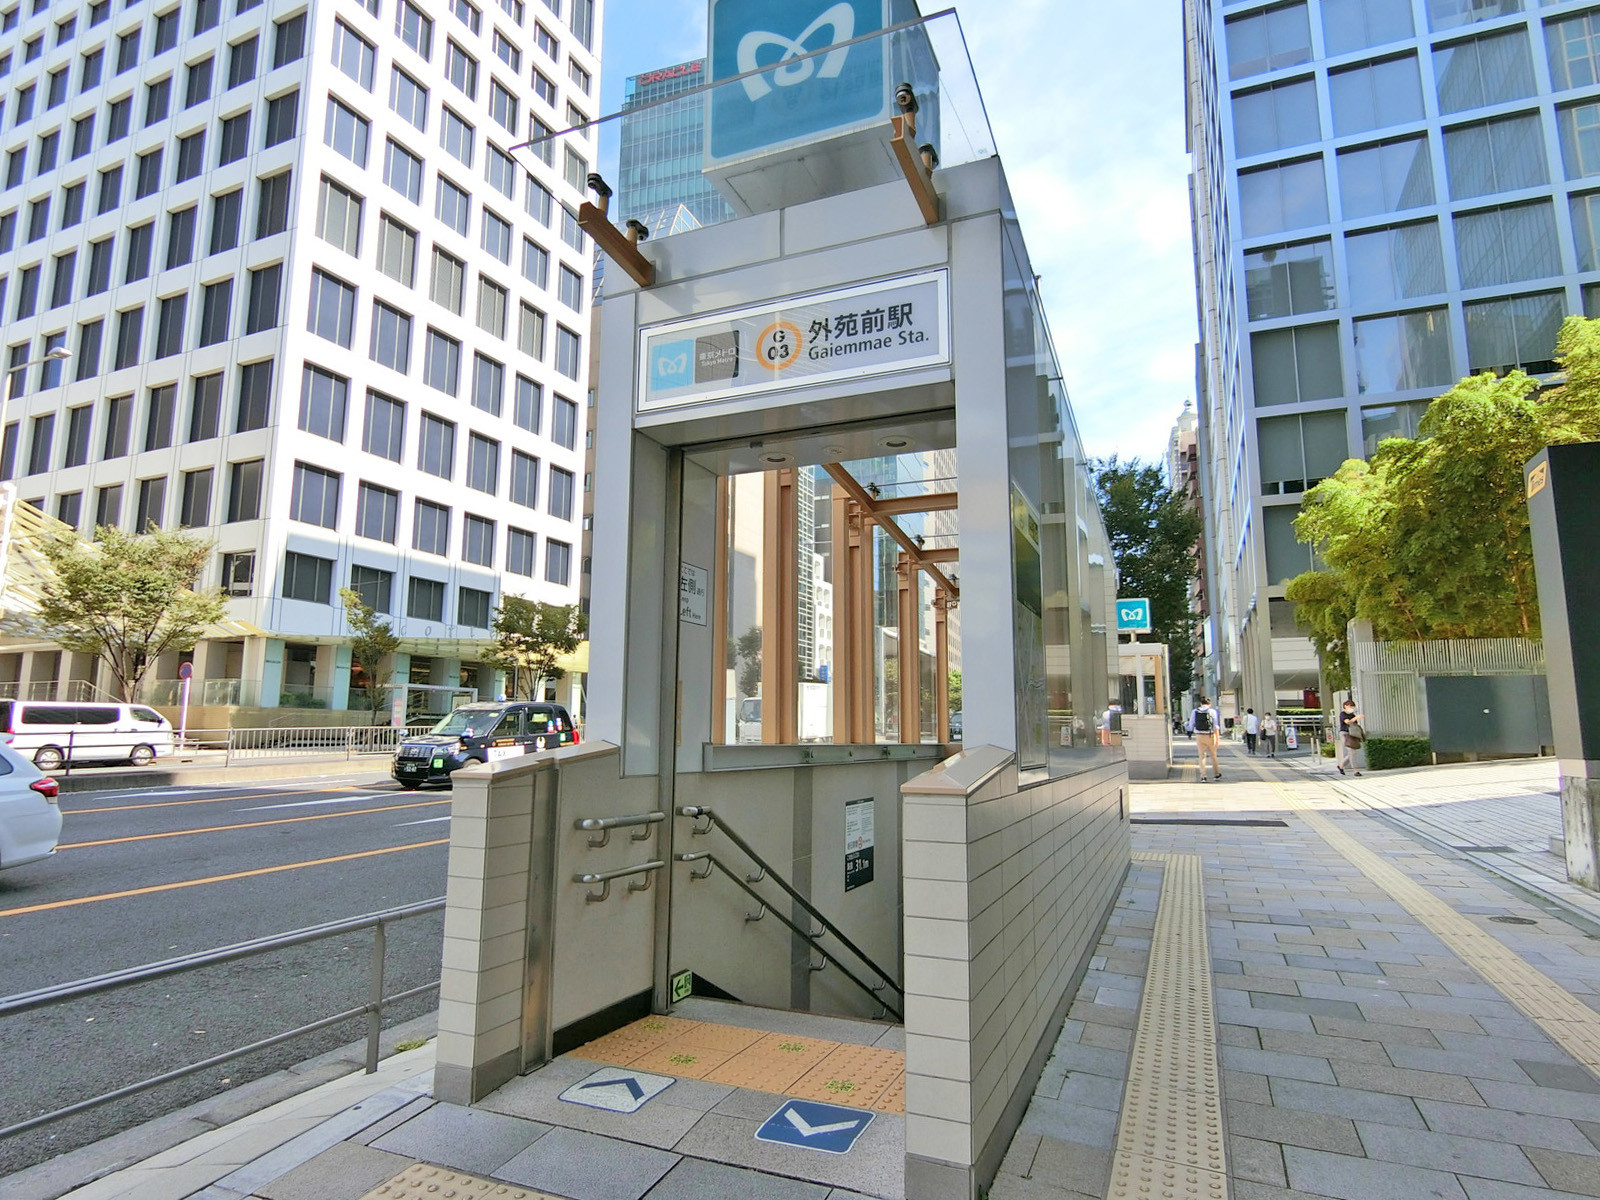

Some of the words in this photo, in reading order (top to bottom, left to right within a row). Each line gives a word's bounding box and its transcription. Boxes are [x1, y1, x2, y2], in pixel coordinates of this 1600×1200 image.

[638, 61, 702, 86] ORACLE
[808, 302, 914, 344] 外苑前駅
[772, 329, 786, 344] G
[808, 334, 893, 361] Gaiemmae
[898, 329, 930, 345] Sta.
[767, 343, 790, 361] 03
